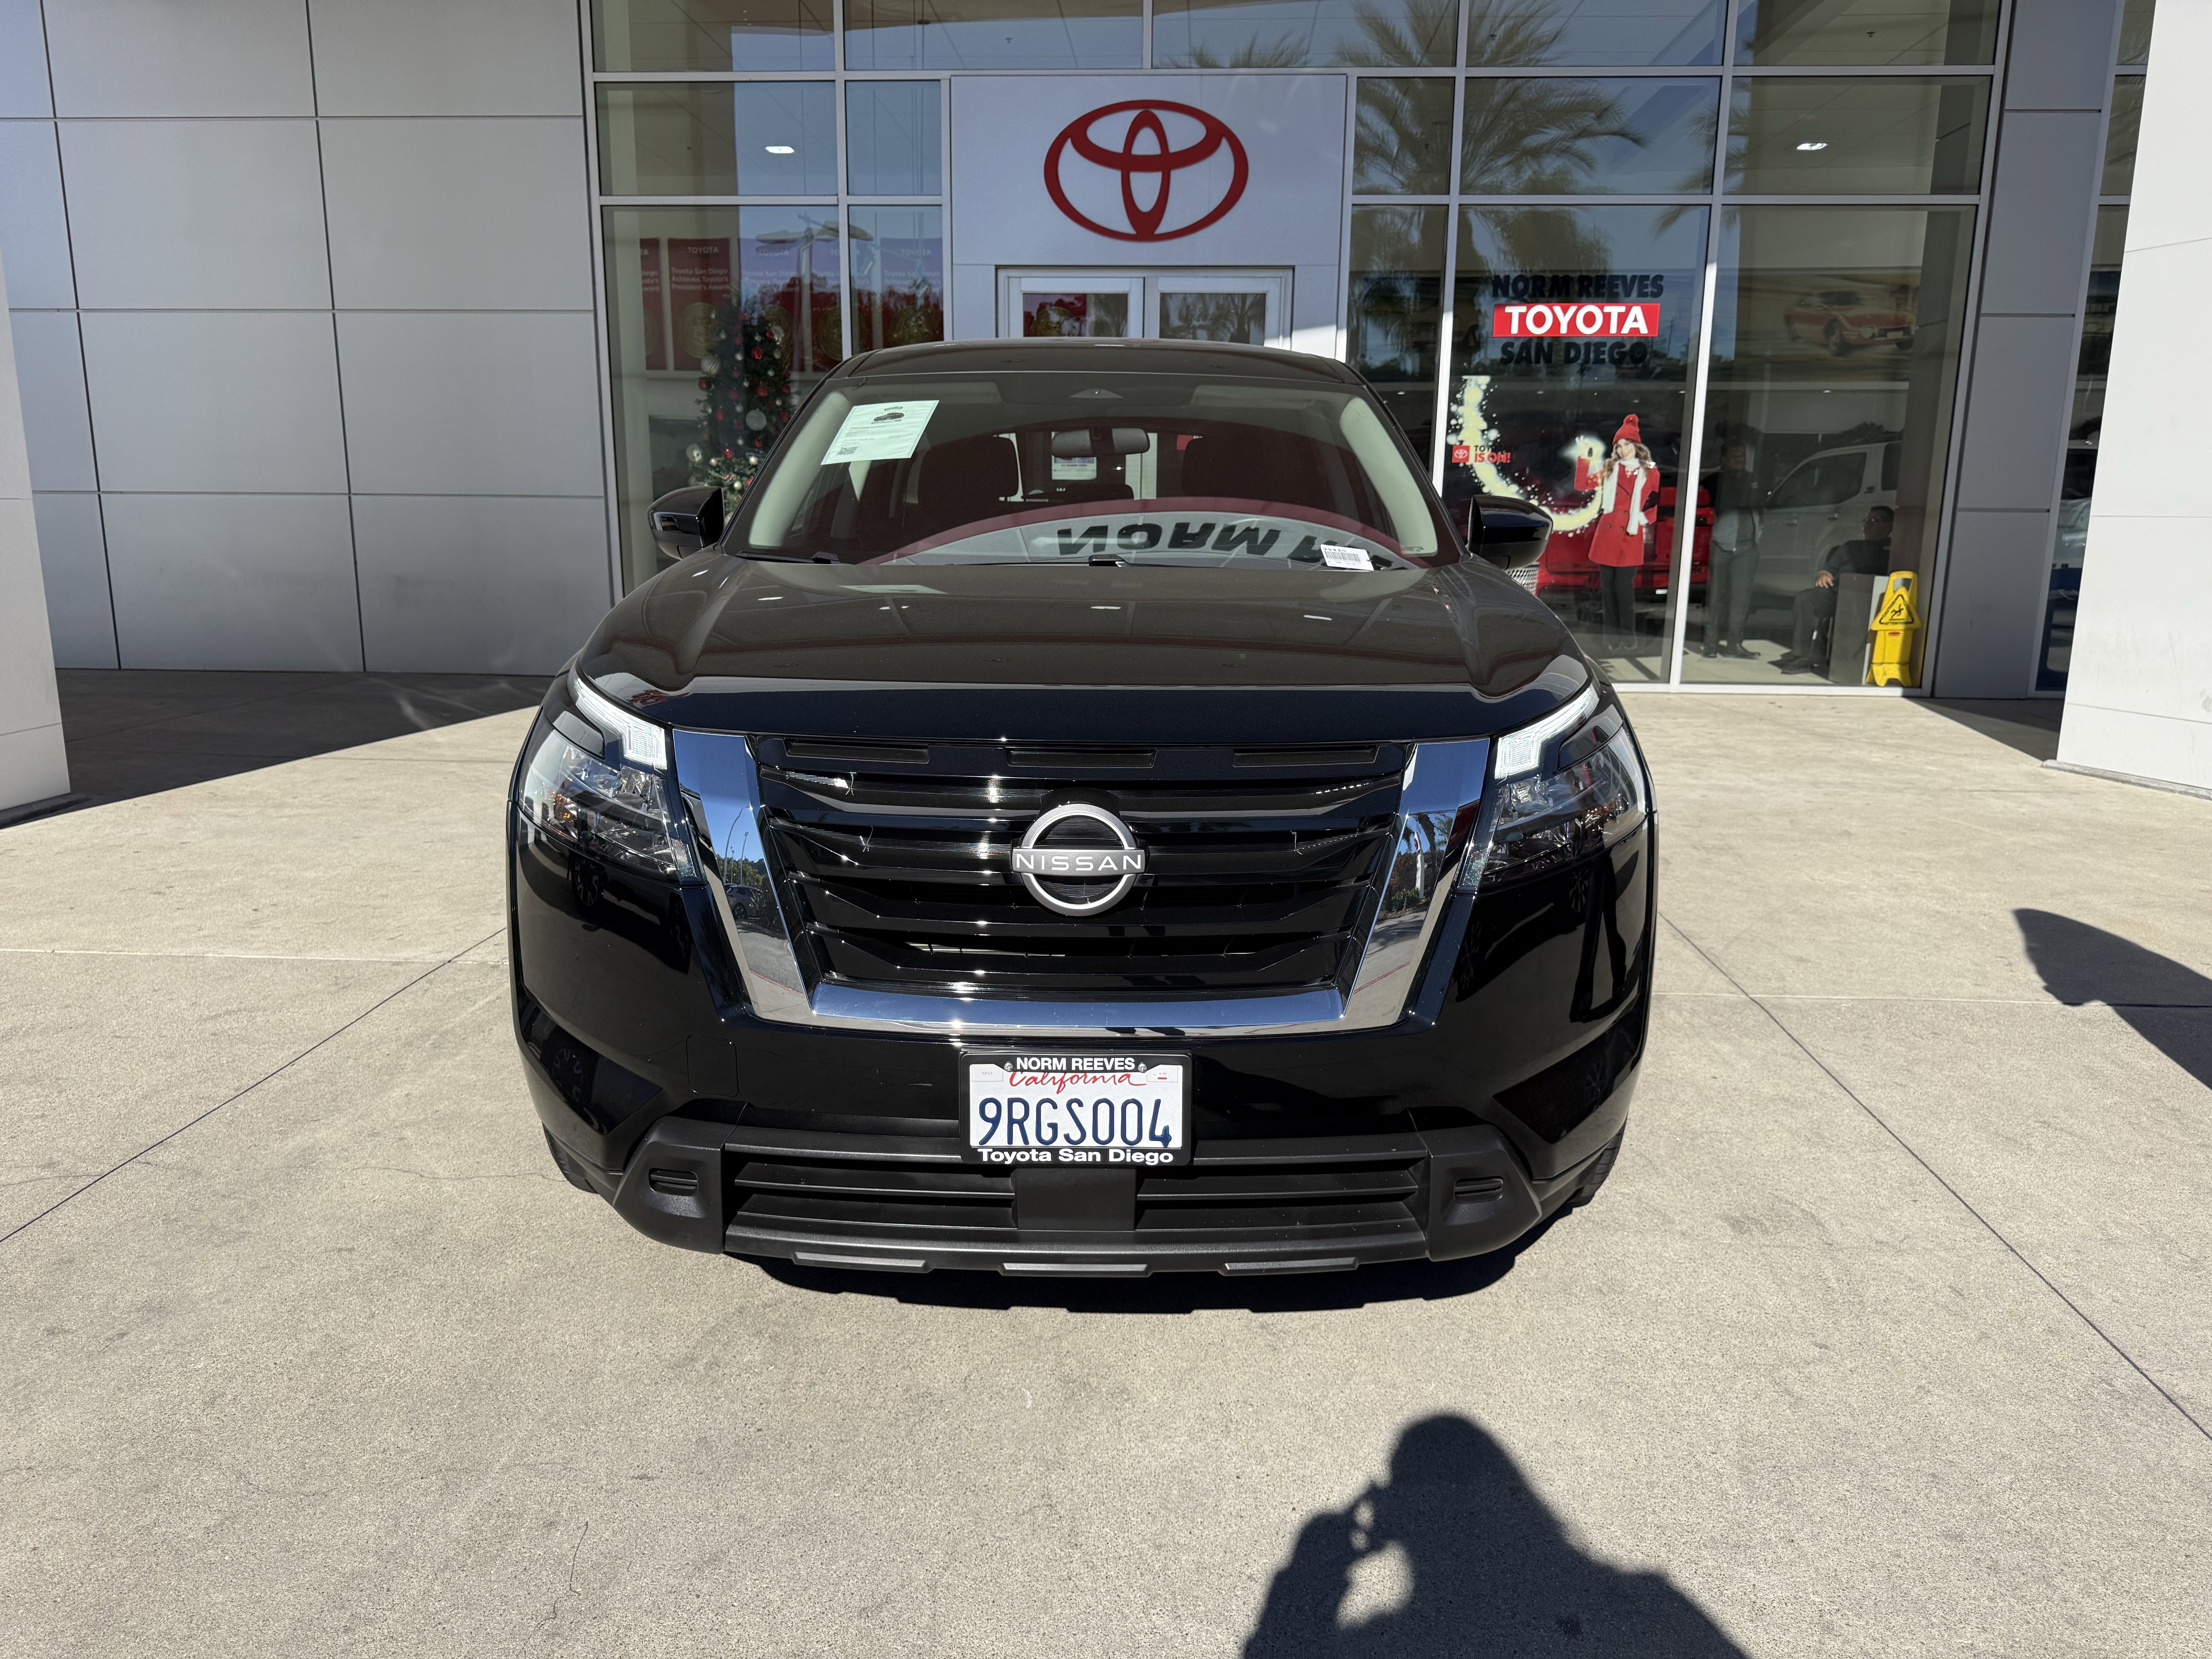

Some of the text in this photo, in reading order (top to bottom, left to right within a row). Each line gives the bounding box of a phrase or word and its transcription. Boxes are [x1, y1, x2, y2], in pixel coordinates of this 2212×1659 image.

[1492, 274, 1664, 298] NORM REEVES
[1505, 304, 1649, 335] TOYOTA
[1500, 342, 1648, 365] SAN DIEGO
[1474, 452, 1511, 463] IS ON!
[1016, 853, 1141, 871] NISSAN
[1017, 1057, 1135, 1070] NORM REEVES
[1009, 1071, 1147, 1094] California
[979, 1097, 1172, 1147] 9RGS004
[977, 1148, 1173, 1165] Toyota San Diego
